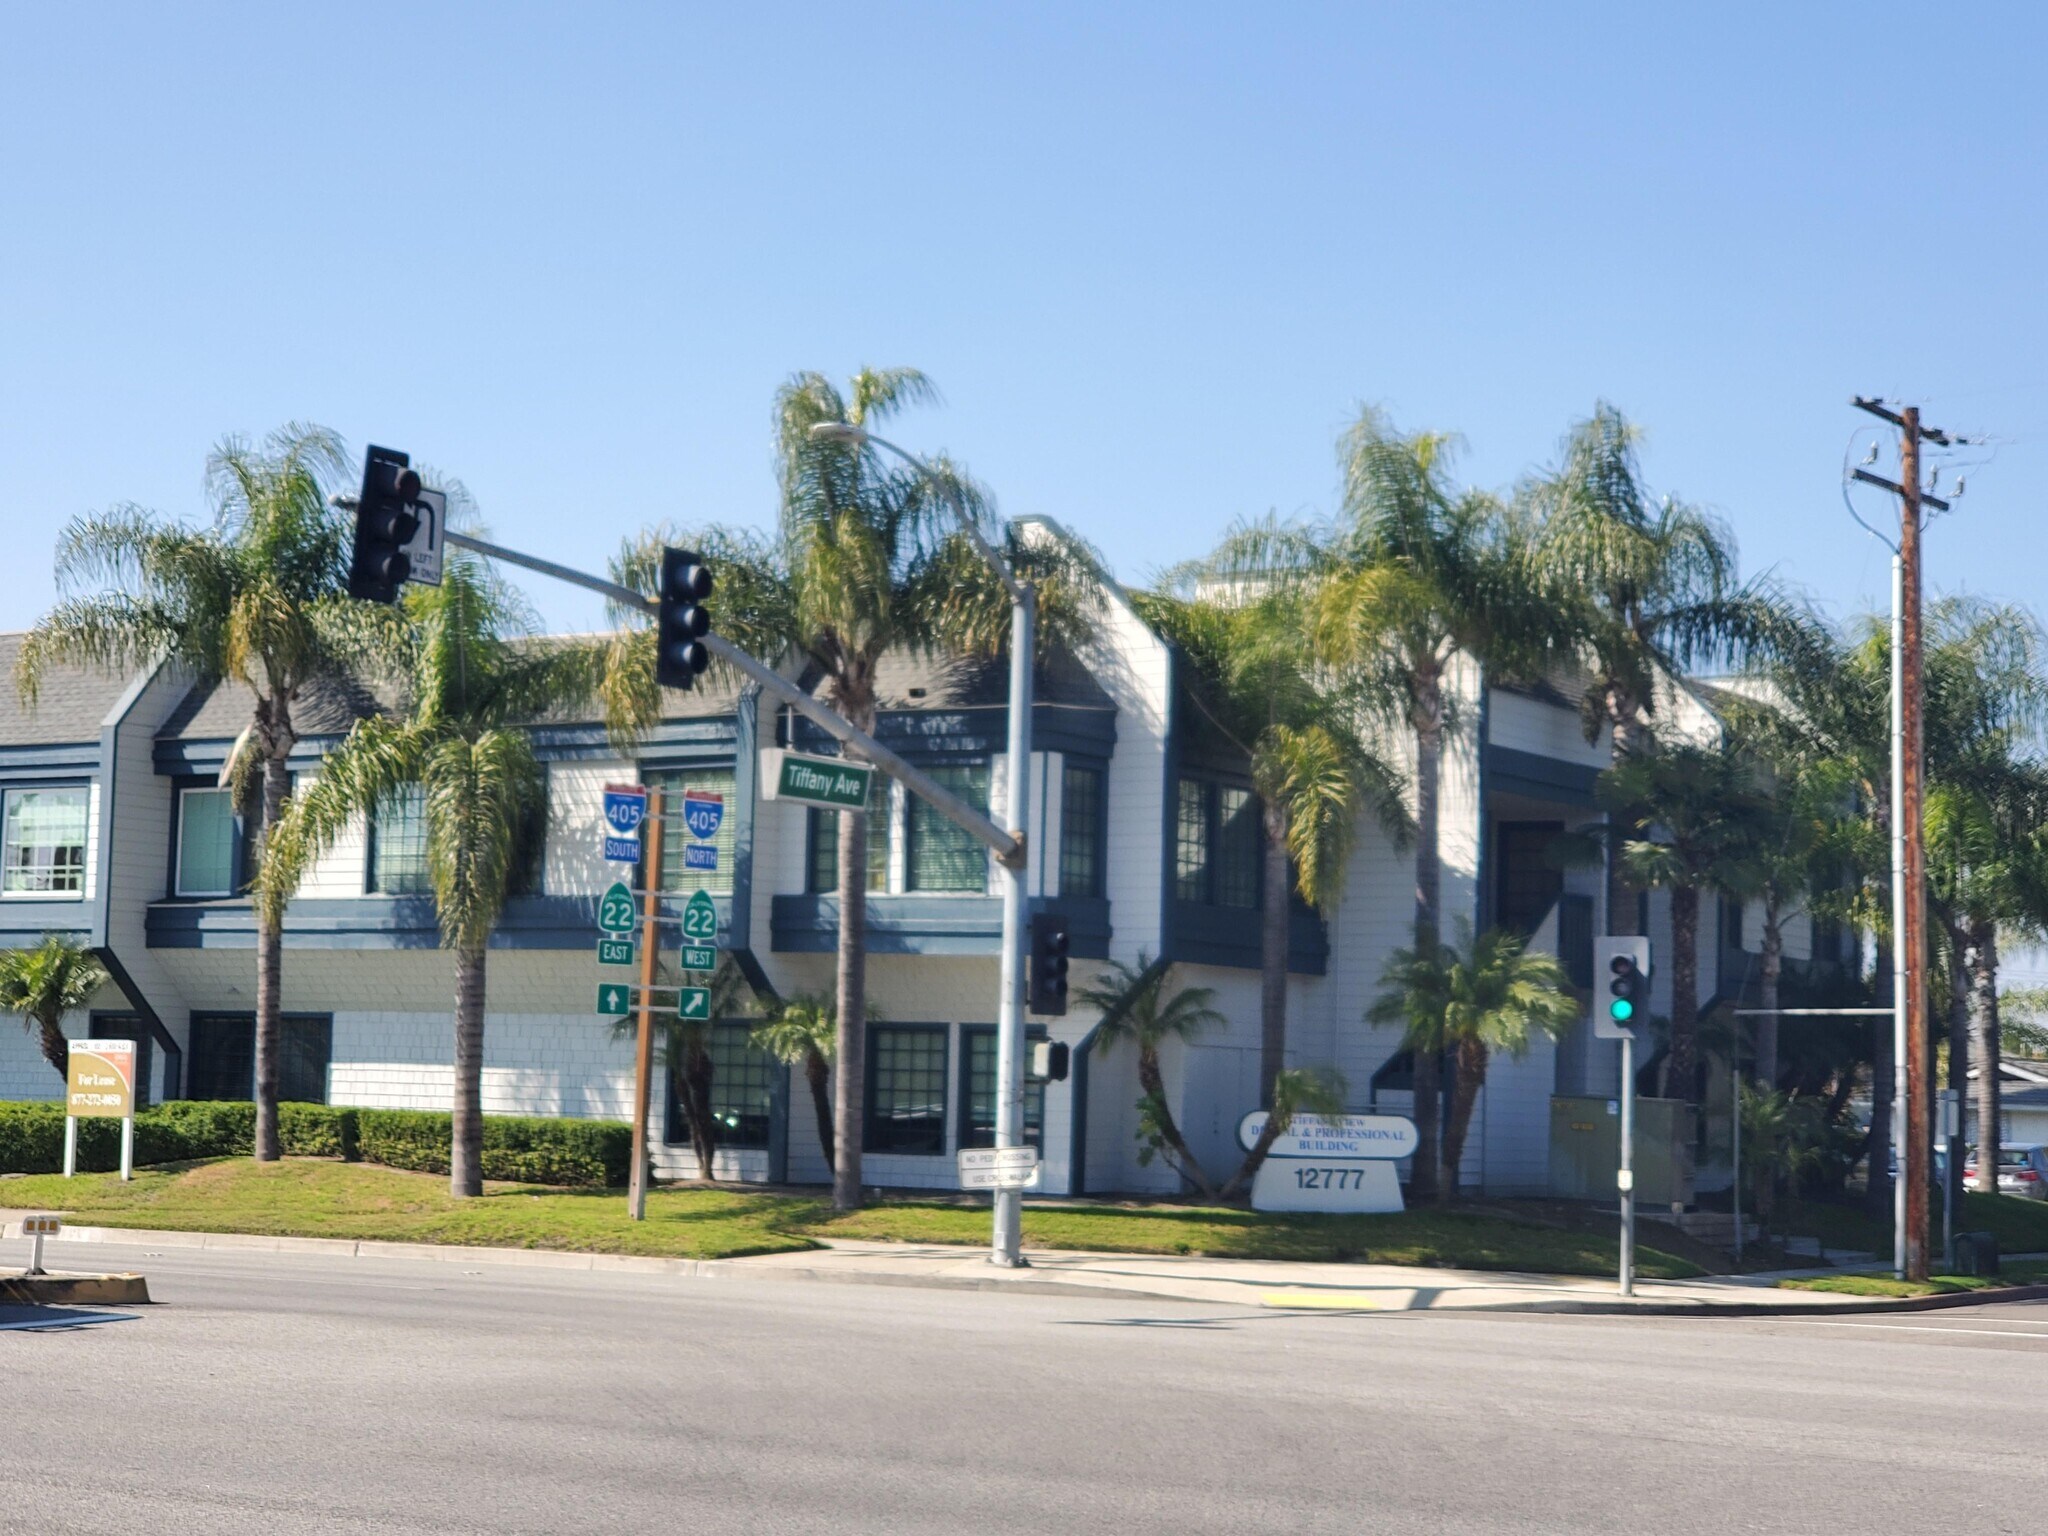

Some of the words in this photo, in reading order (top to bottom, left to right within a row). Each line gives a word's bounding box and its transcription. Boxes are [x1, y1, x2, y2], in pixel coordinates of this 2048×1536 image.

[789, 765, 834, 797] Tiffany
[834, 773, 861, 796] Ave
[608, 804, 640, 824] 405
[689, 811, 718, 831] 405
[606, 840, 638, 858] SOUTH
[687, 847, 717, 865] NORTH
[604, 902, 631, 926] 22
[687, 909, 713, 932] 22
[603, 943, 628, 960] EAST
[686, 949, 711, 965] WEST
[1292, 1116, 1334, 1127] TIFFAN
[1302, 1127, 1311, 1137] &
[1315, 1128, 1406, 1142] PROFESSIONAL
[1299, 1140, 1359, 1152] BUILDING
[1294, 1167, 1365, 1191] 12777
